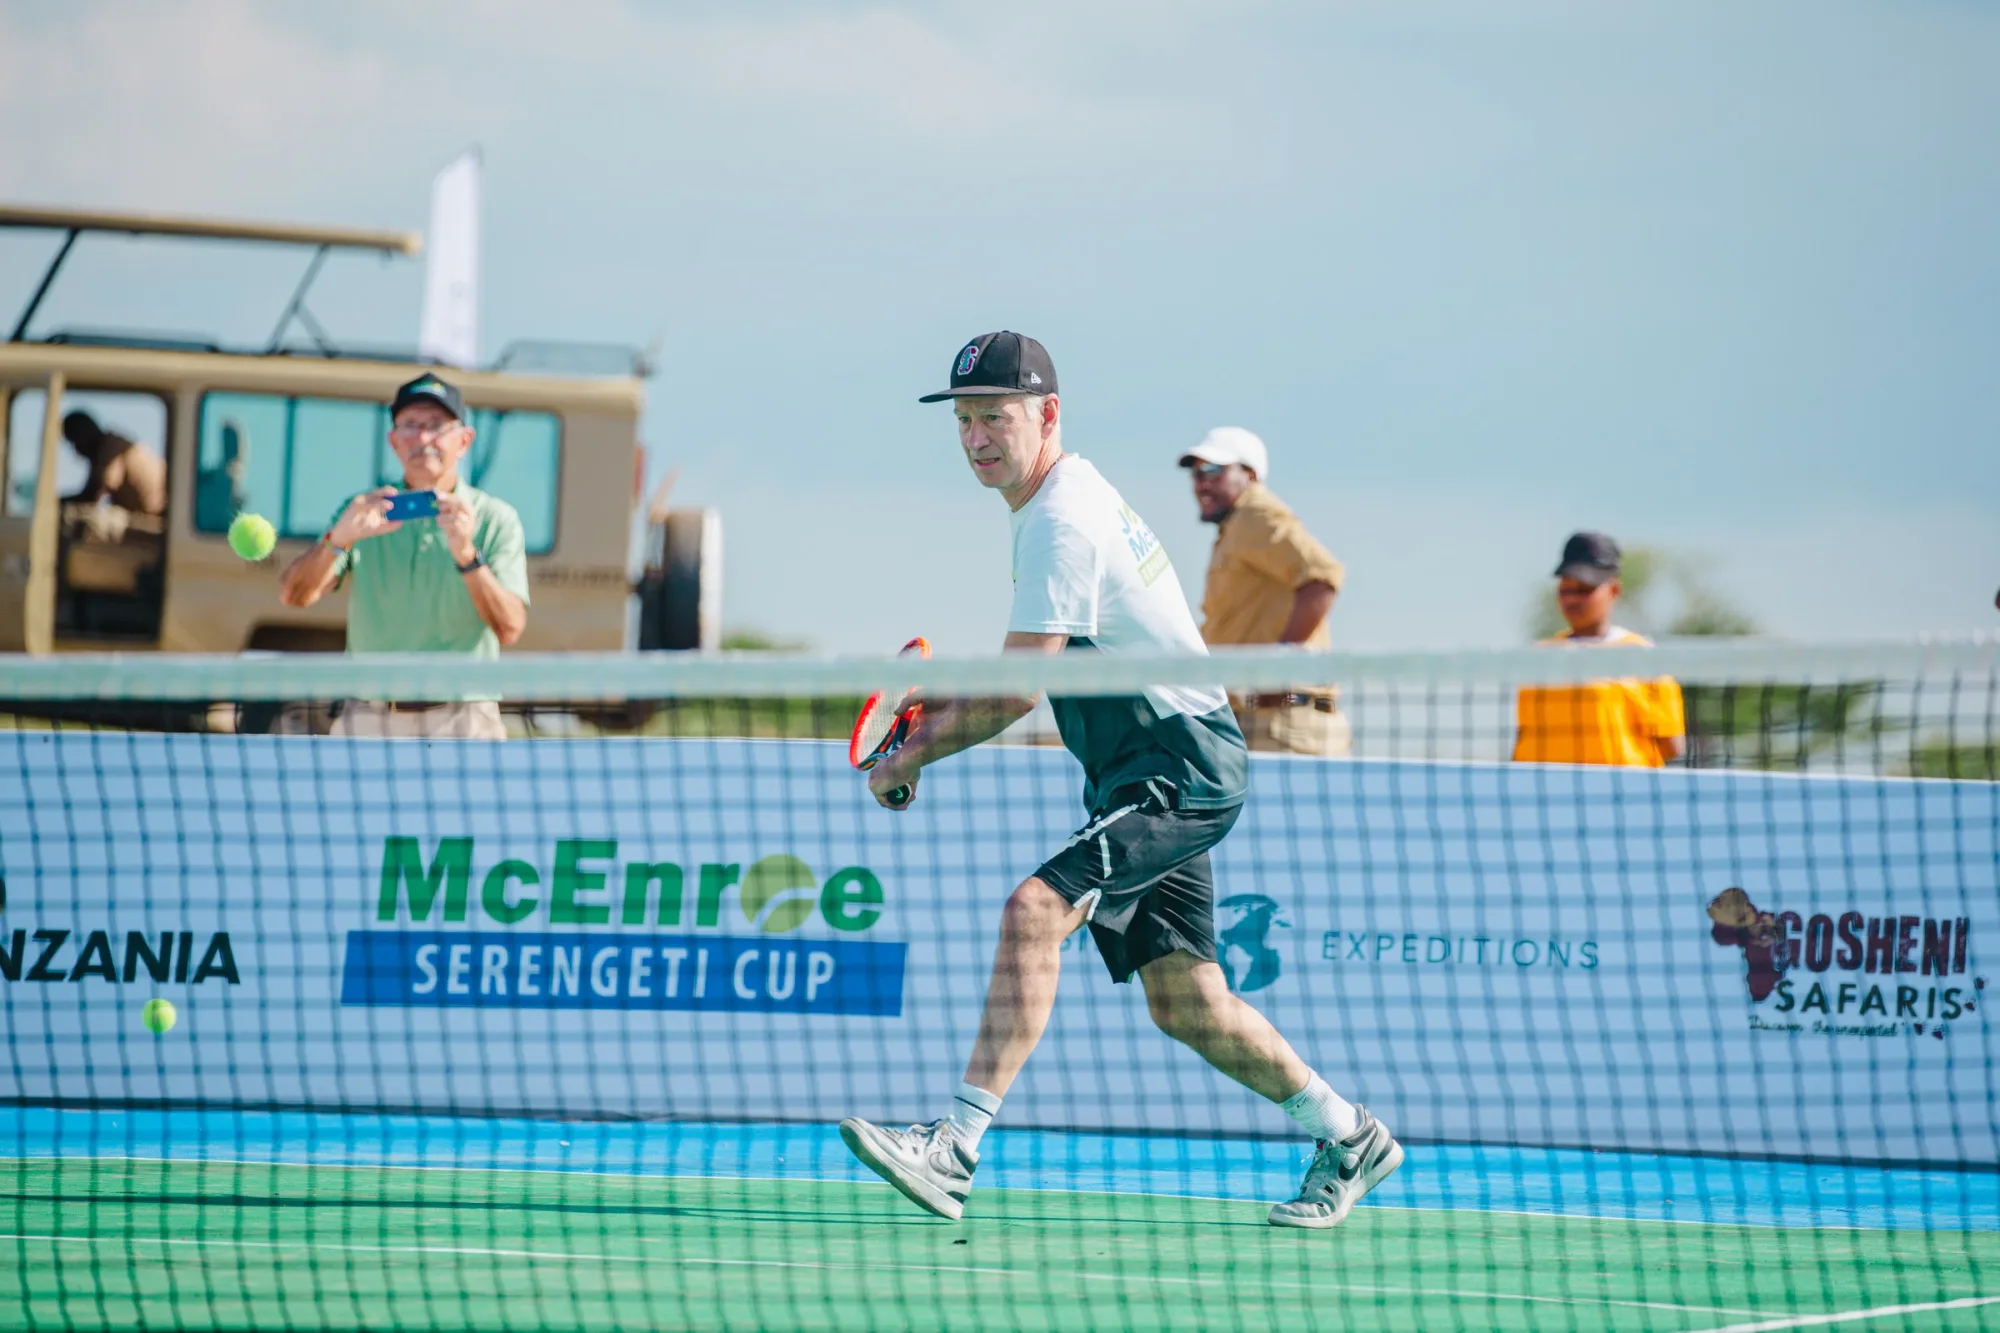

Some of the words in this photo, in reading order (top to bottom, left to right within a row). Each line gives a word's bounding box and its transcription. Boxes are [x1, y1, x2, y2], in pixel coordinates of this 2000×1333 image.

[376, 836, 885, 933] McEnroe
[1322, 931, 1599, 969] EXPEDITIONS
[1772, 911, 1970, 976] GOSHENI
[412, 944, 708, 998] SERENGETI
[734, 949, 835, 1002] CUP
[1775, 980, 1962, 1019] SAFARIS
